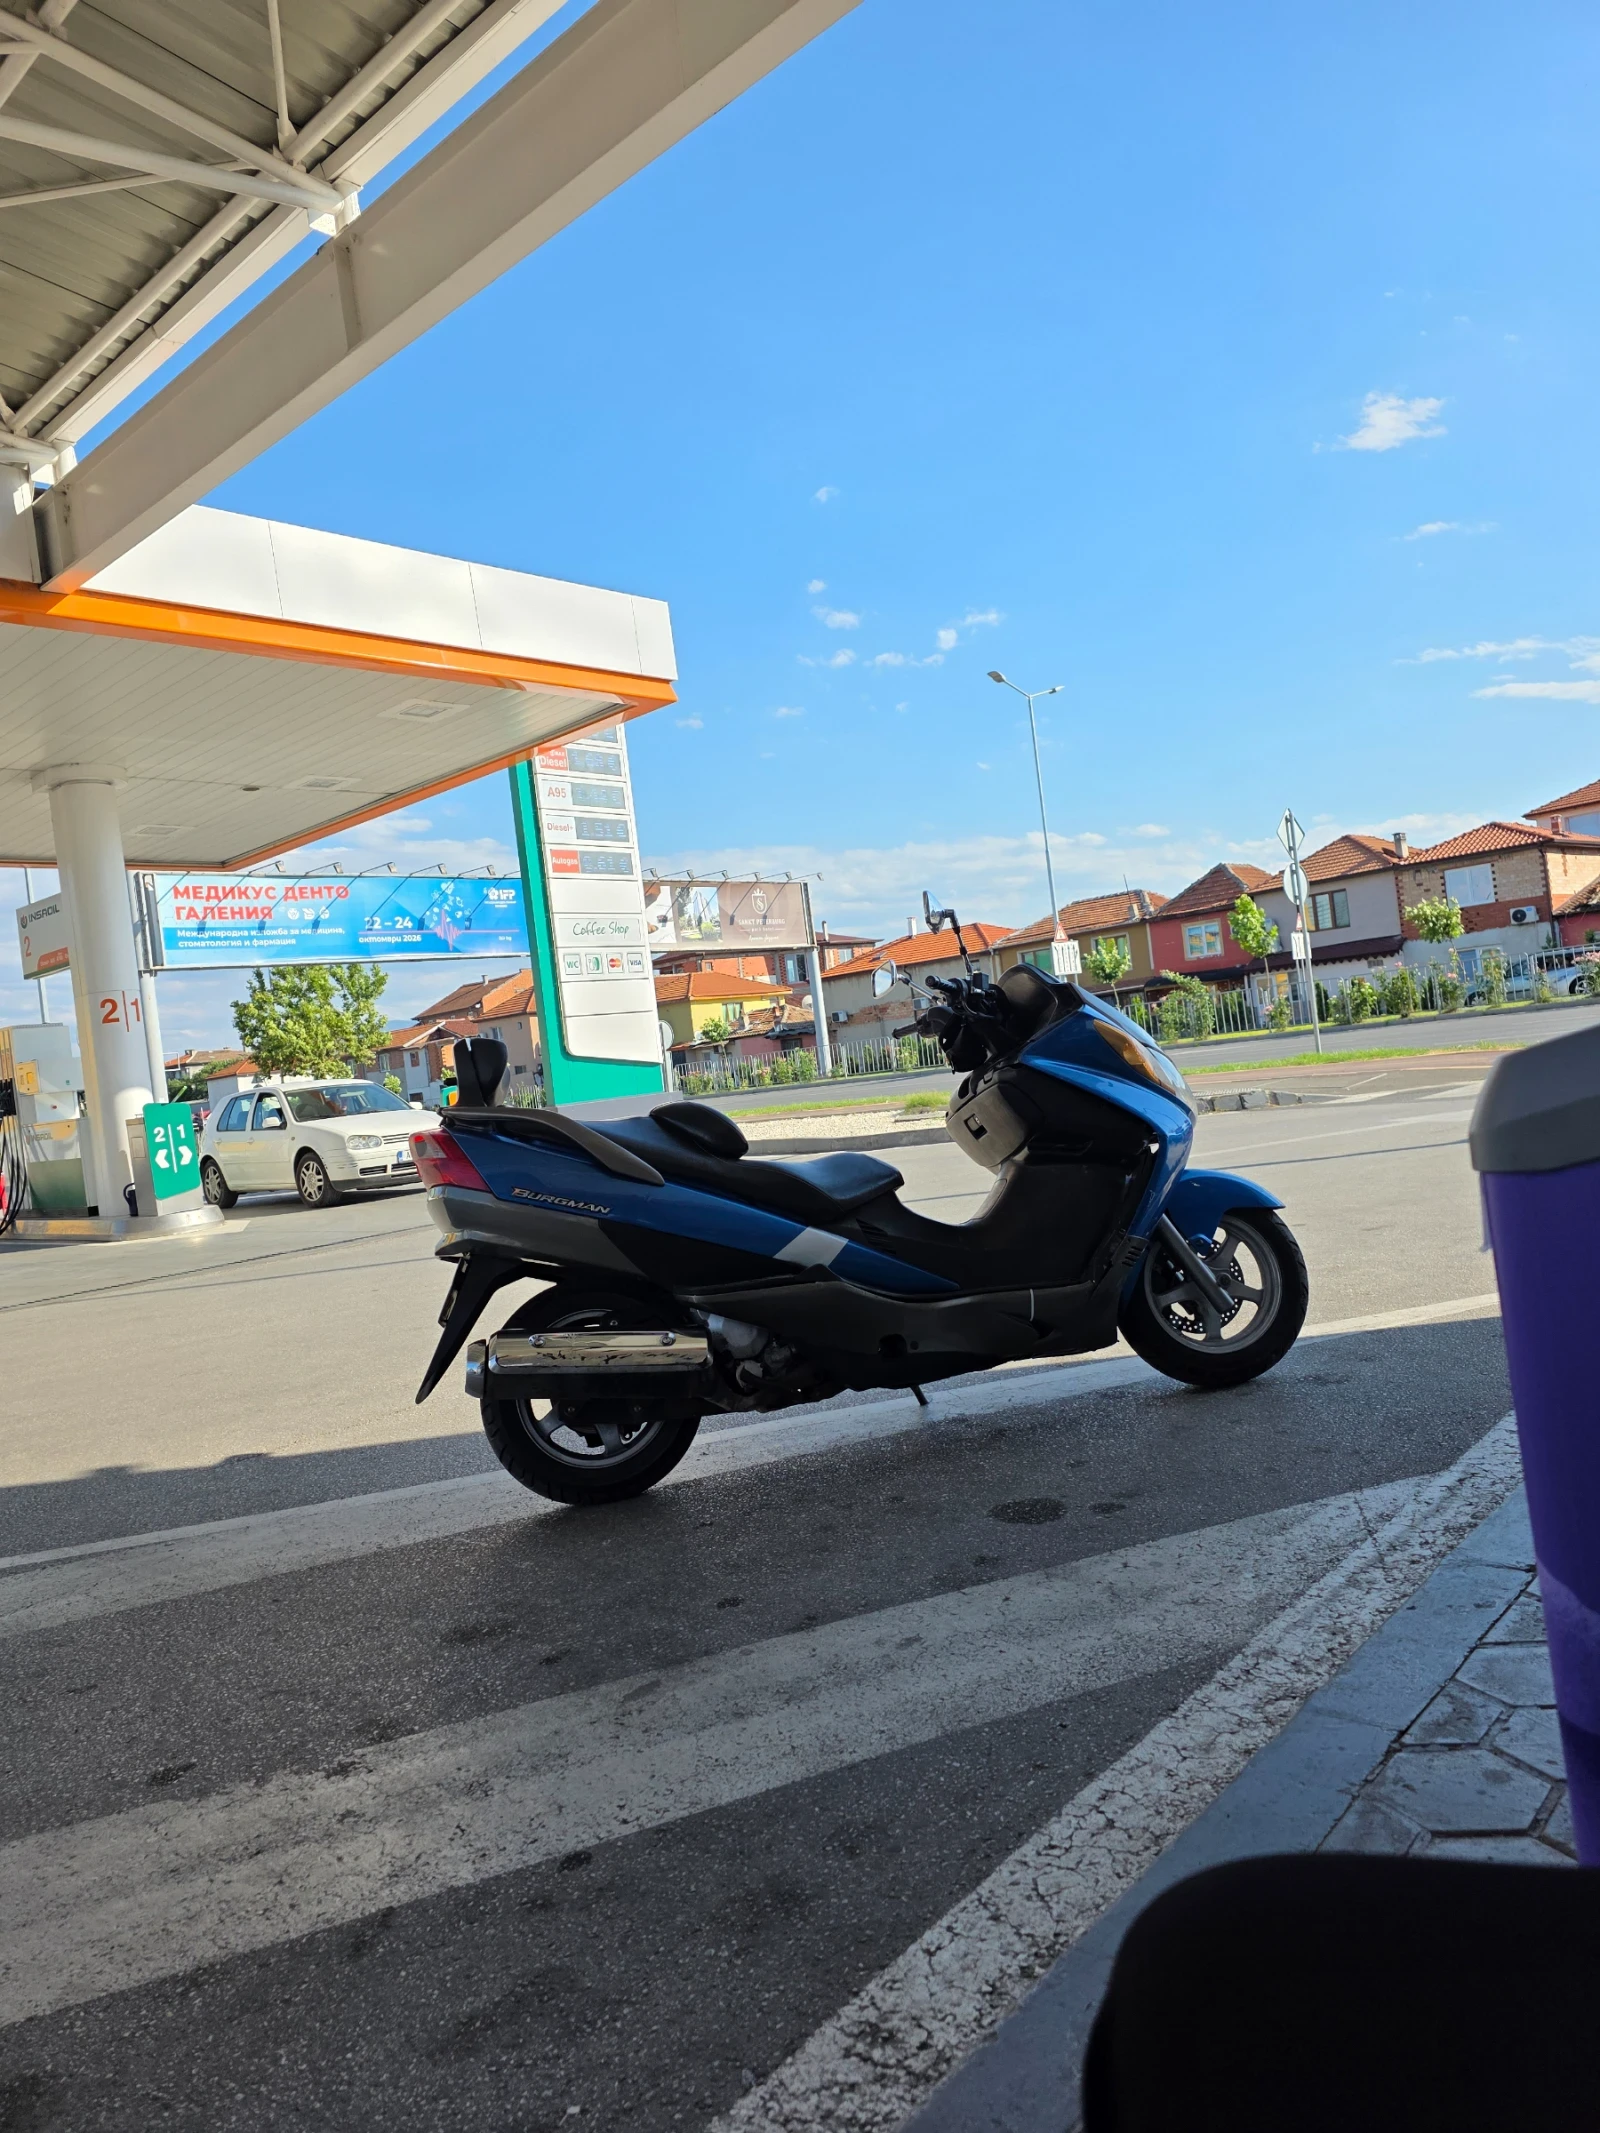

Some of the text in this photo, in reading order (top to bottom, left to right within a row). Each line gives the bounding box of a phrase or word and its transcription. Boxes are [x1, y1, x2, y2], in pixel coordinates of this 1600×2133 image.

[540, 755, 567, 768] Diesel
[547, 786, 567, 799] A95
[547, 822, 574, 832] Diesel+
[552, 856, 578, 867] Autogas
[172, 885, 350, 902] МЕДИКУС ДЕНТО
[28, 904, 60, 923] INSAOIL
[174, 906, 273, 921] ГАЛЕНИЯ
[363, 916, 382, 930] 22
[395, 916, 413, 929] 24
[177, 929, 249, 938] Международна
[572, 921, 629, 939] Coffee Shop
[178, 939, 243, 948] стоматология
[252, 937, 296, 947] фармация
[403, 934, 422, 943] 2026
[23, 935, 32, 958] 2
[566, 960, 580, 969] WC
[153, 1123, 186, 1143] 2 1
[512, 1187, 611, 1214] BURGMAN
